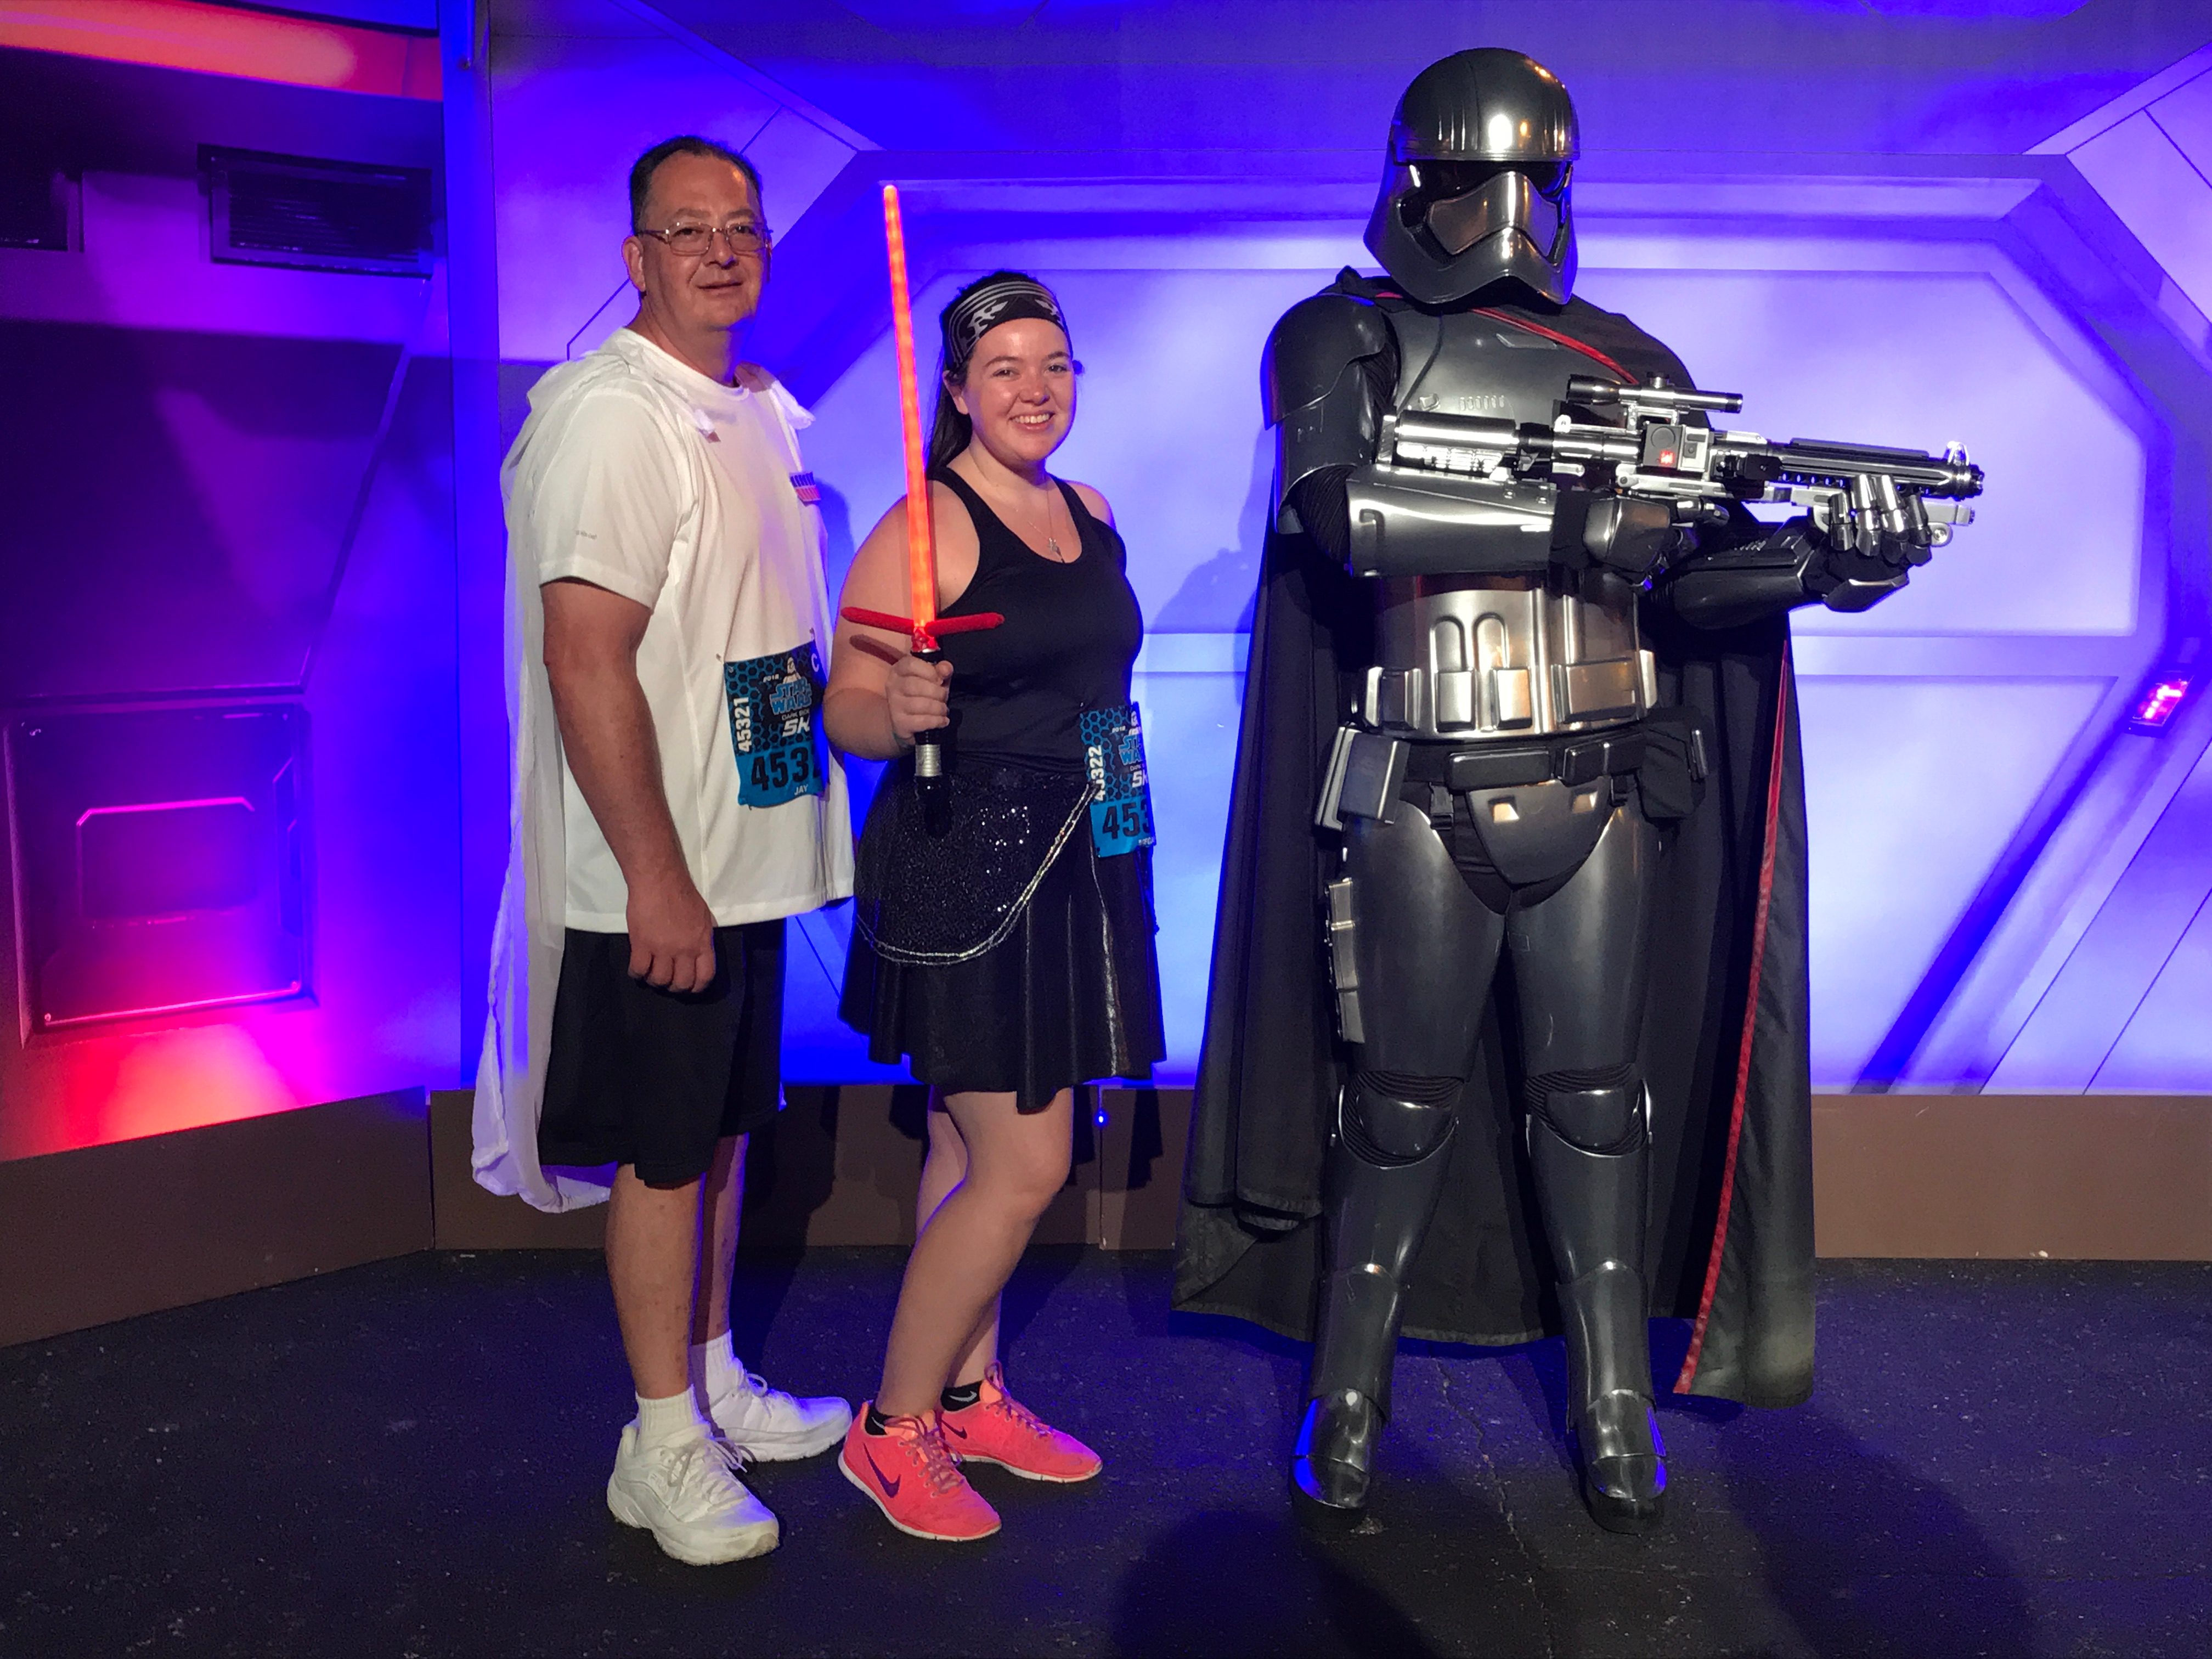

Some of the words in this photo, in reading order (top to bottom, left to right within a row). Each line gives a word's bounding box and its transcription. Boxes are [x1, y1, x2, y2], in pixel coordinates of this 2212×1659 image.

[770, 676, 812, 700] STAR
[770, 693, 812, 715] WARS
[733, 697, 752, 752] 45321
[782, 716, 810, 737] 5K
[794, 784, 809, 795] JAY
